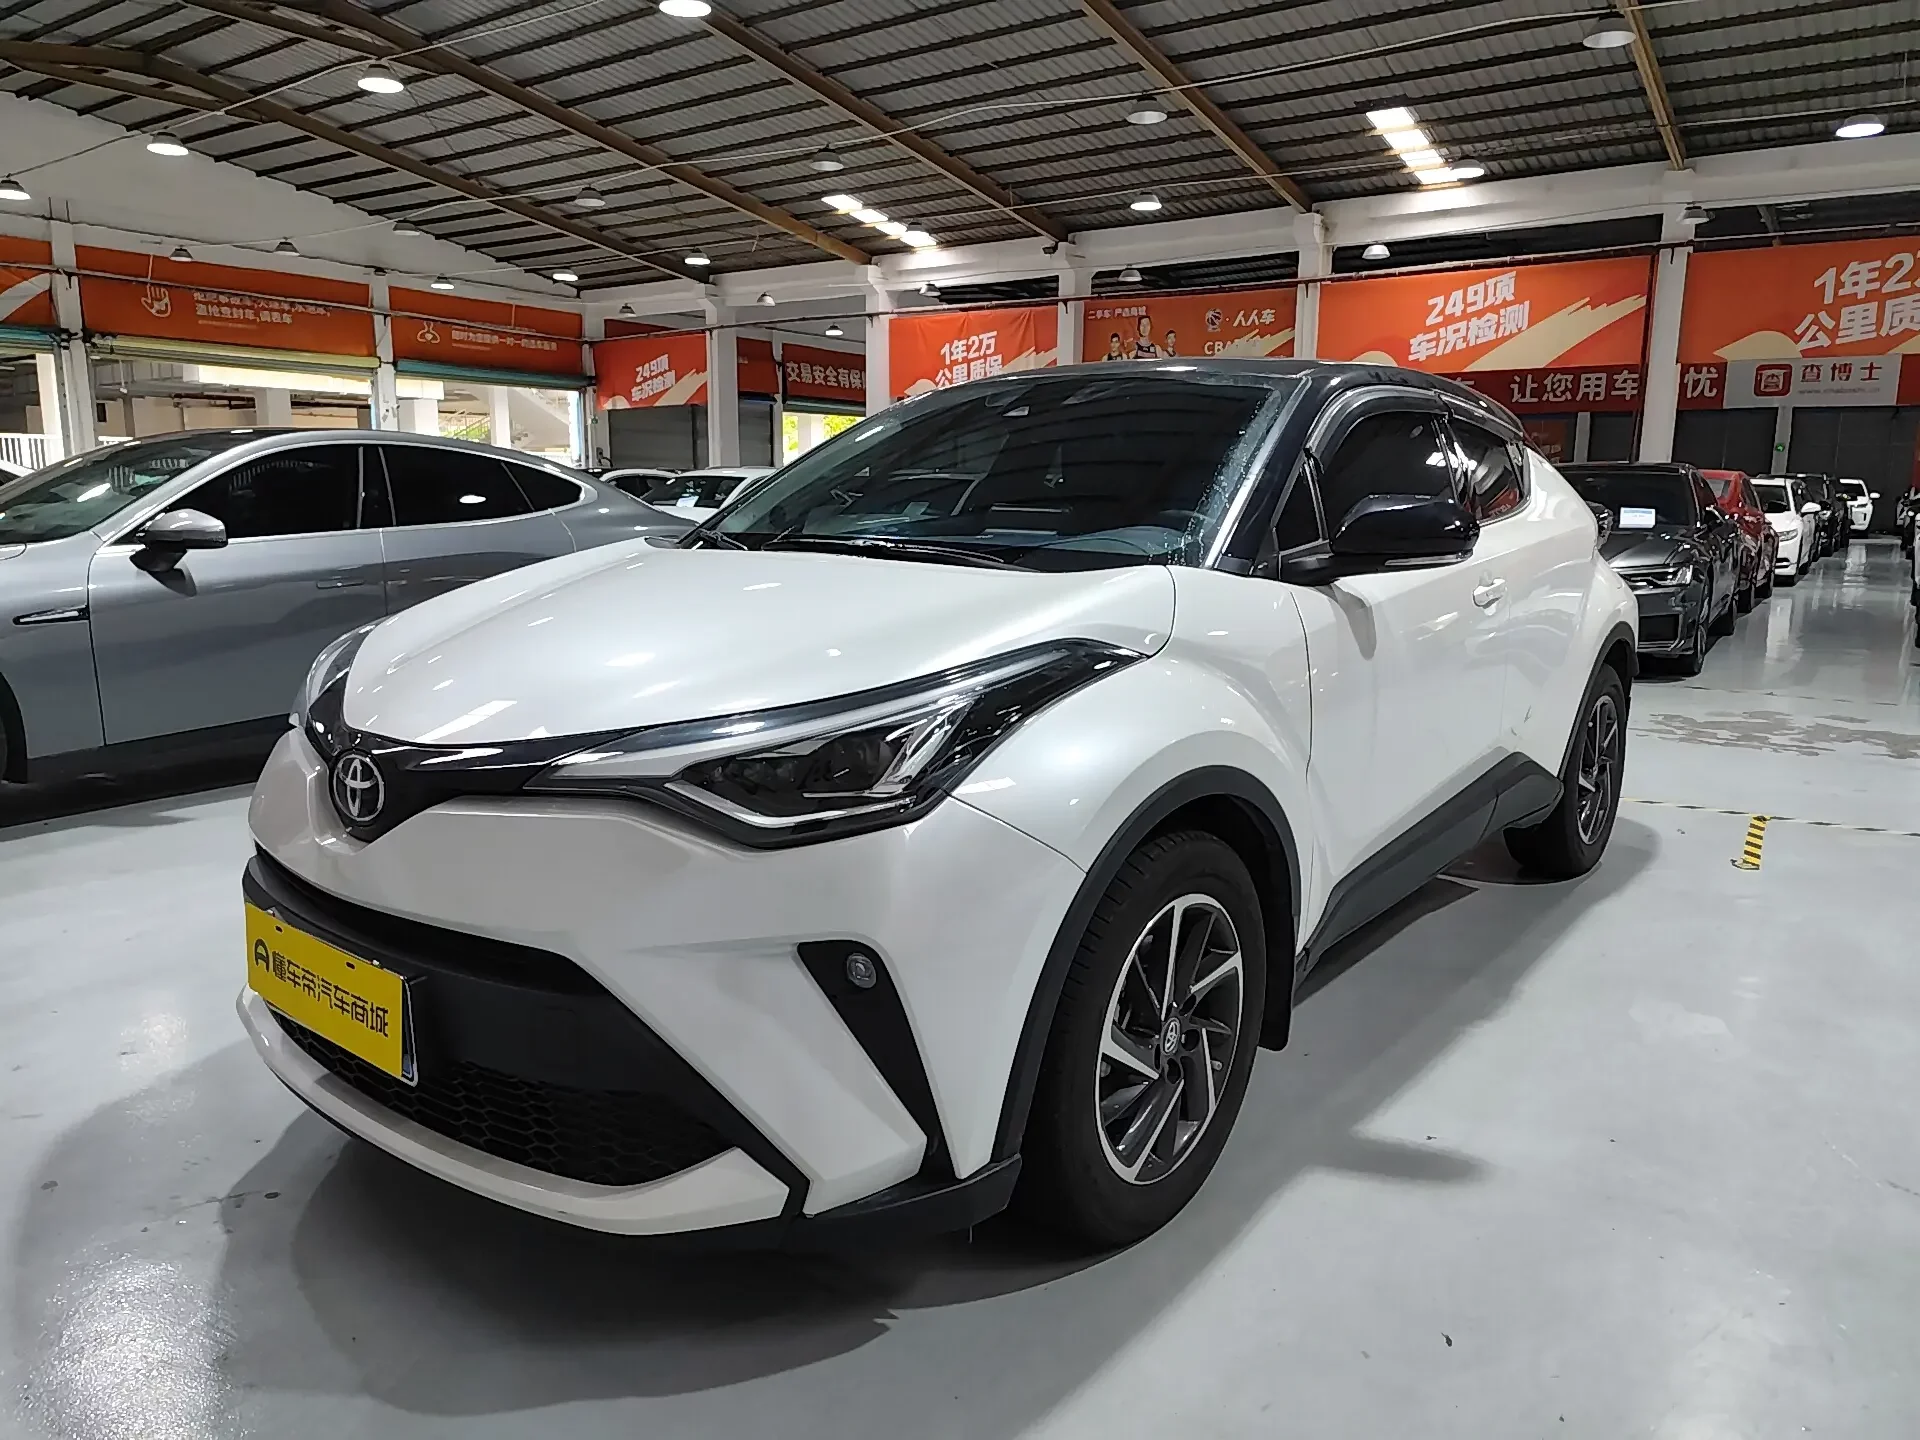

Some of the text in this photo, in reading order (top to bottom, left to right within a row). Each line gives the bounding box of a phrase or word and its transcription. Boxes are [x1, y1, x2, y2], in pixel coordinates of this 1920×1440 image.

[1813, 249, 1920, 304] 1年2
[1425, 271, 1517, 326] 249项
[1233, 308, 1276, 327] 人人车
[1408, 300, 1530, 361] 车况检测
[940, 330, 998, 365] 1年2万
[635, 354, 669, 383] 249项
[786, 361, 866, 389] 交易安全有保
[935, 354, 1003, 388] 公里质保
[1801, 362, 1882, 383] 查博士
